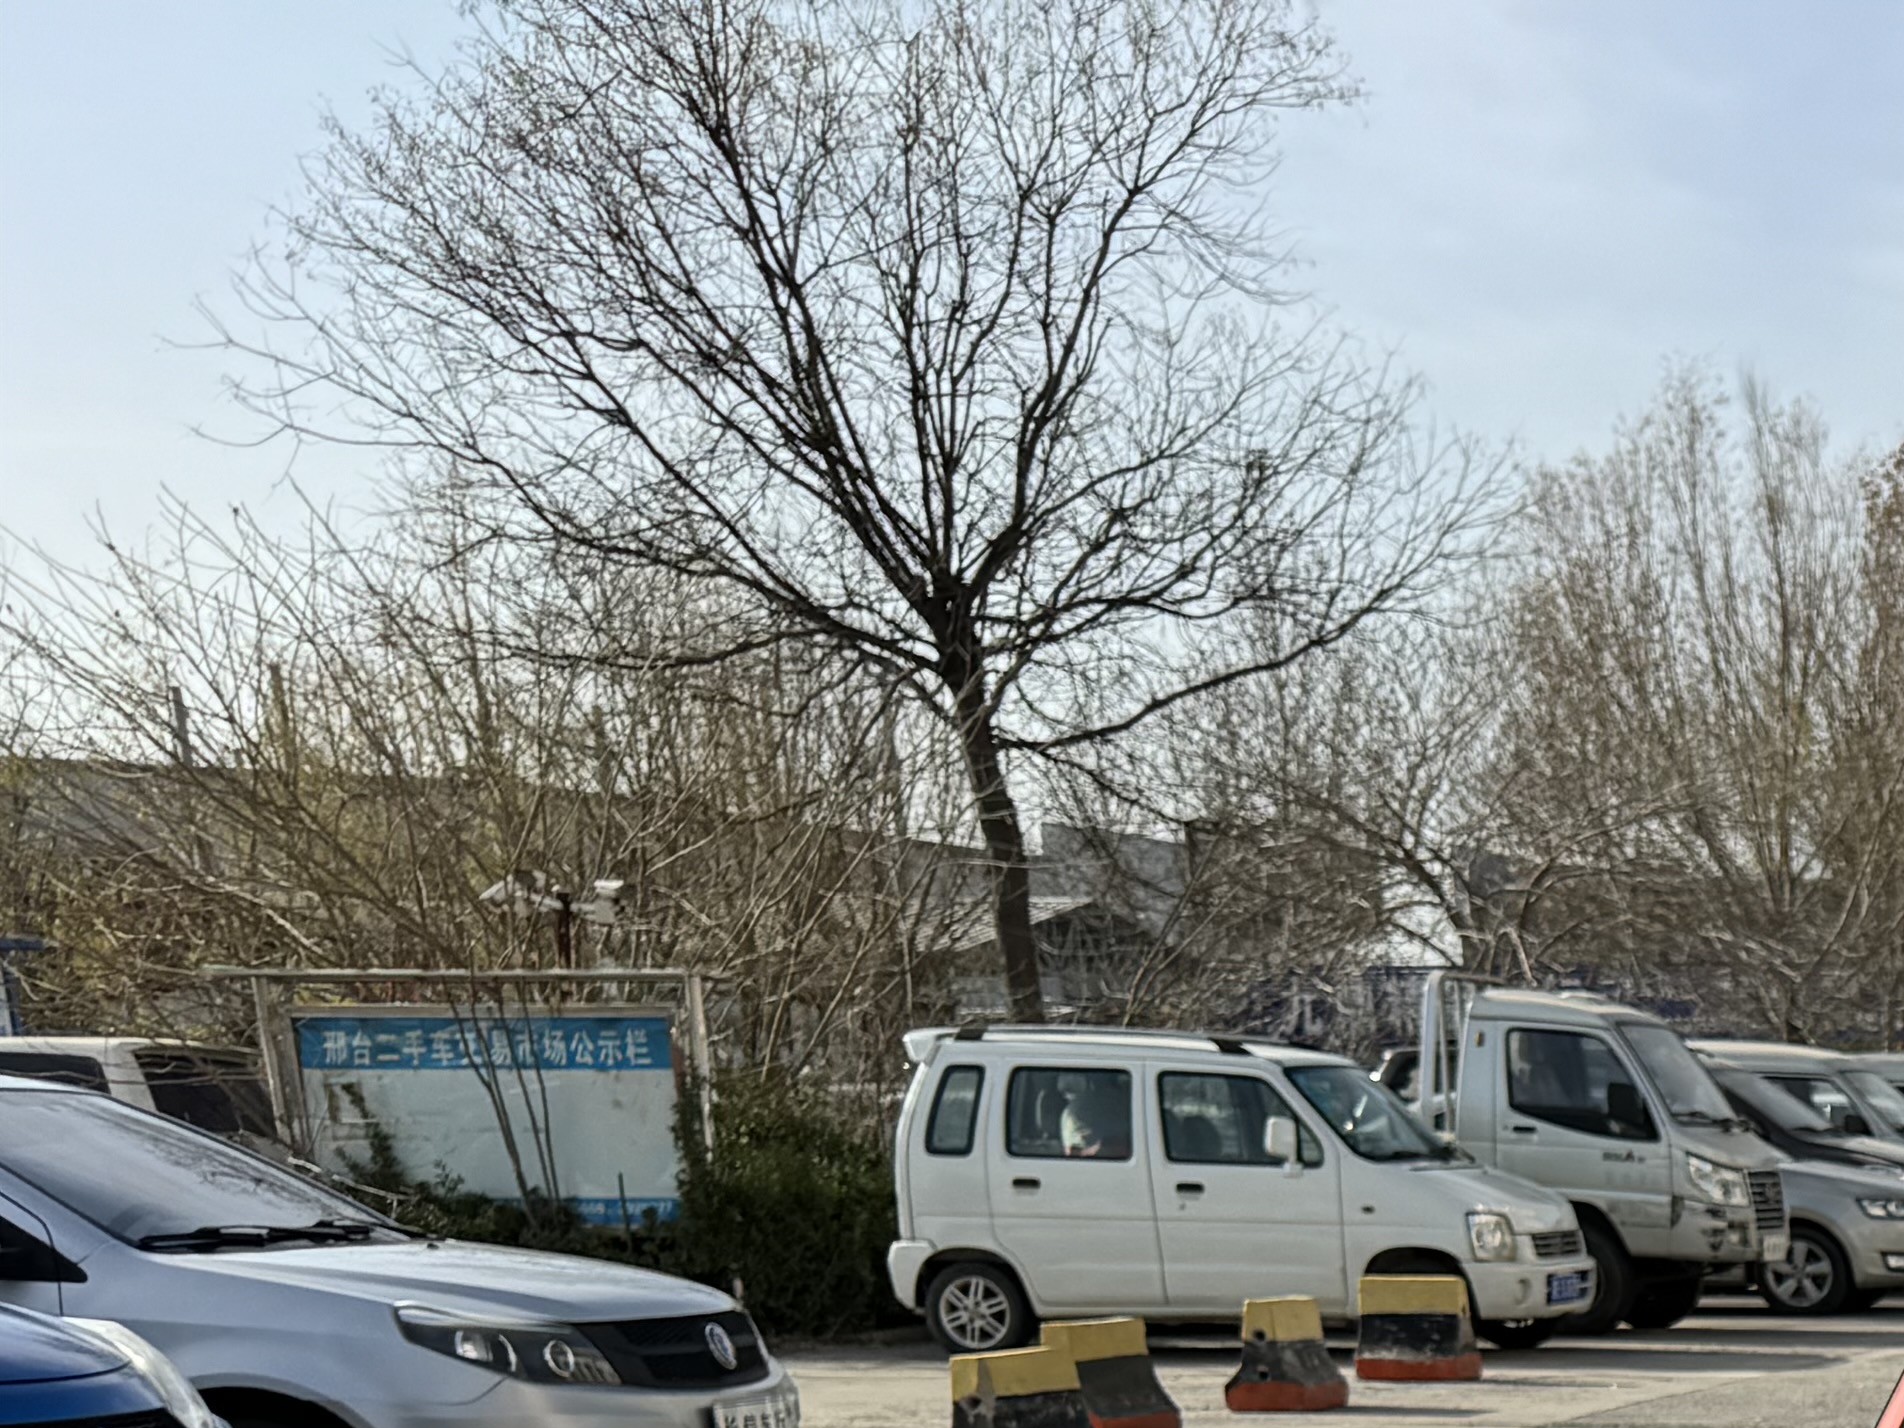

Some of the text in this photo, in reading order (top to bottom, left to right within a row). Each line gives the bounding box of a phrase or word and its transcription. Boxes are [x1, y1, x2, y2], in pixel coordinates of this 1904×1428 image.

[322, 1028, 653, 1067] 邢台二手车交易市场公示栏
